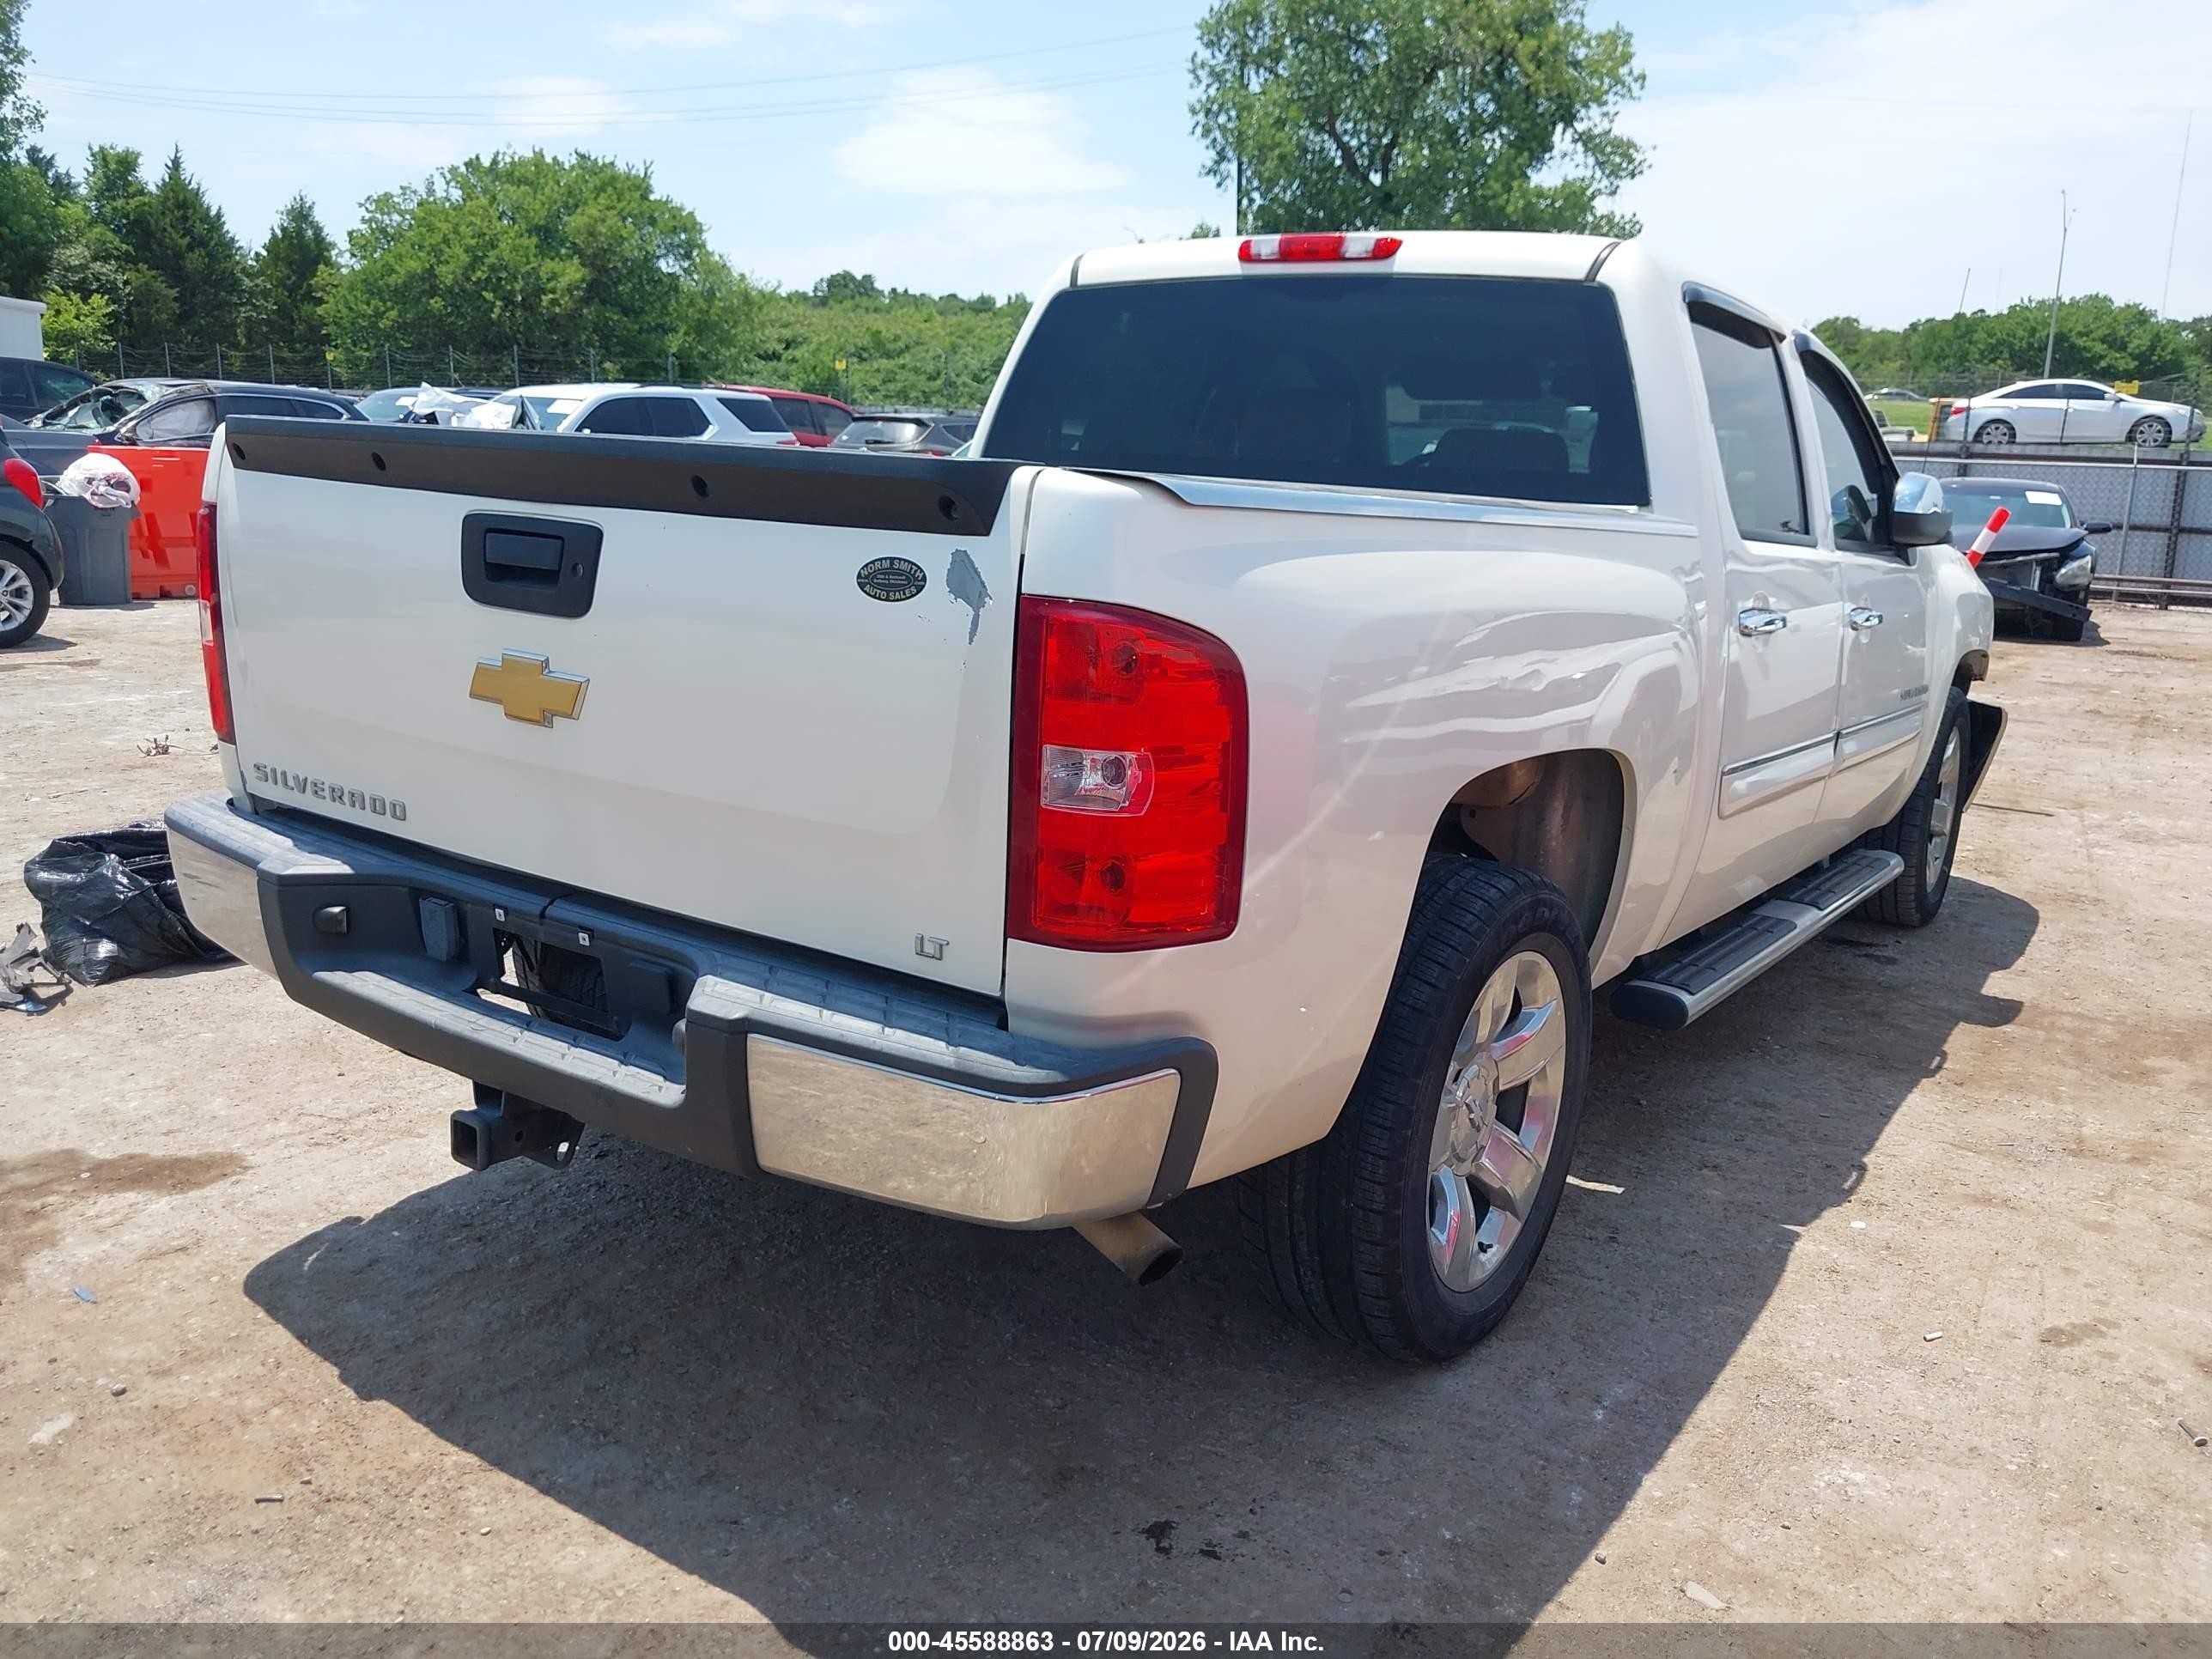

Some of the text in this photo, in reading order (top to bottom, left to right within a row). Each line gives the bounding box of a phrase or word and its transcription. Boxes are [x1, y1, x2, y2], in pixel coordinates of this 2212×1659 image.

[860, 559, 924, 580] NORM SMITH
[864, 584, 917, 600] AUTO SALES
[253, 762, 407, 822] SILVERADO
[915, 933, 950, 961] LT
